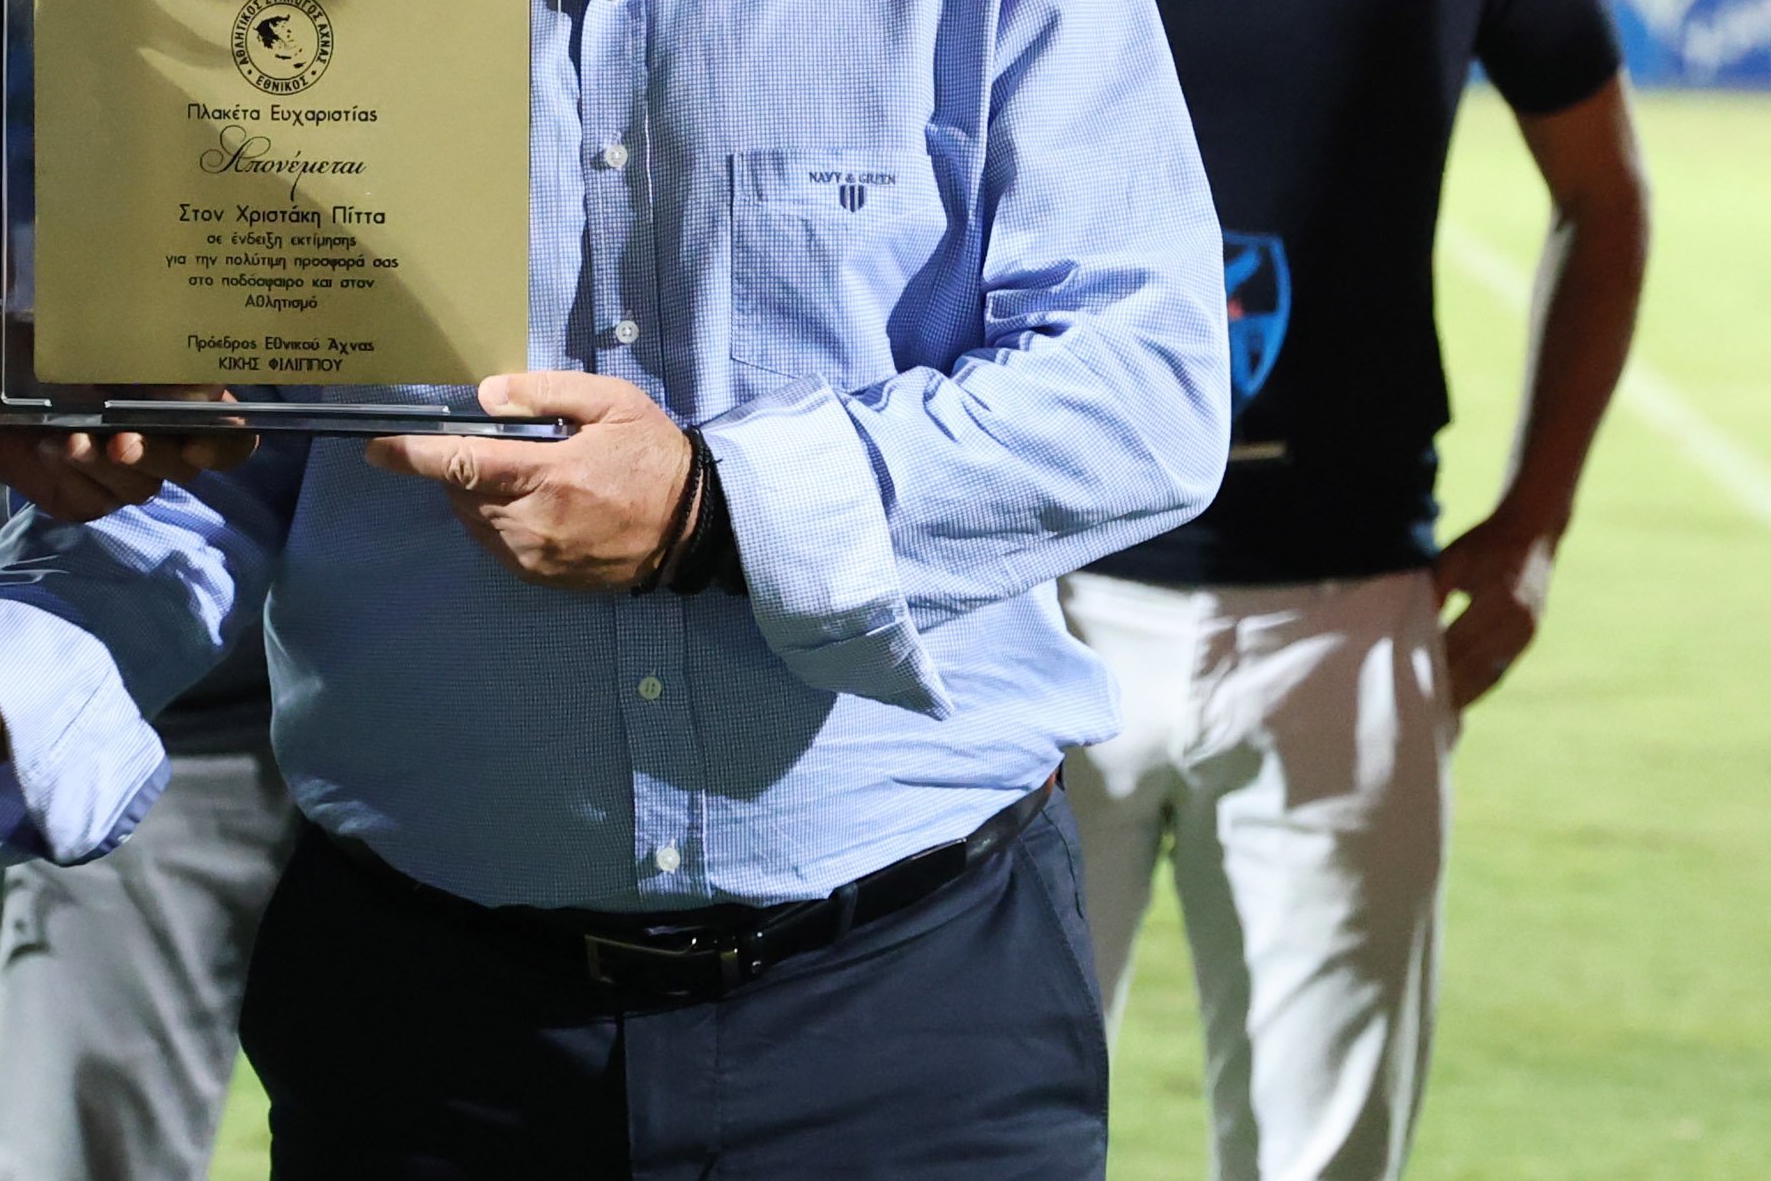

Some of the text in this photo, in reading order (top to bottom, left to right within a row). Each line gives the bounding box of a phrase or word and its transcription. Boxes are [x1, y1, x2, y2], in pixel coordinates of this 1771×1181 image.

[255, 75, 309, 93] ΕΘΝΙΚΟΣ
[188, 103, 378, 126] Πλακέτα Ευχαριστίας
[199, 124, 367, 203] Απονέμεται
[809, 171, 843, 184] NAVY
[845, 173, 856, 185] &
[179, 204, 386, 228] Στον Χριστάκη Πίττα
[207, 231, 357, 251] σε ένδειξη εκτίμησης
[165, 252, 399, 271] για την πολύτιμη προσφορά σας
[188, 275, 214, 287] στο
[312, 277, 333, 289] και
[340, 277, 375, 289] στον
[244, 294, 318, 312] Αθλητισμό
[187, 334, 258, 353] Πρόεδρος
[265, 336, 320, 351] Εθνικού
[219, 357, 344, 372] ΚΙΚΗΣ ΦΙΛΙΠΠΟΥ
